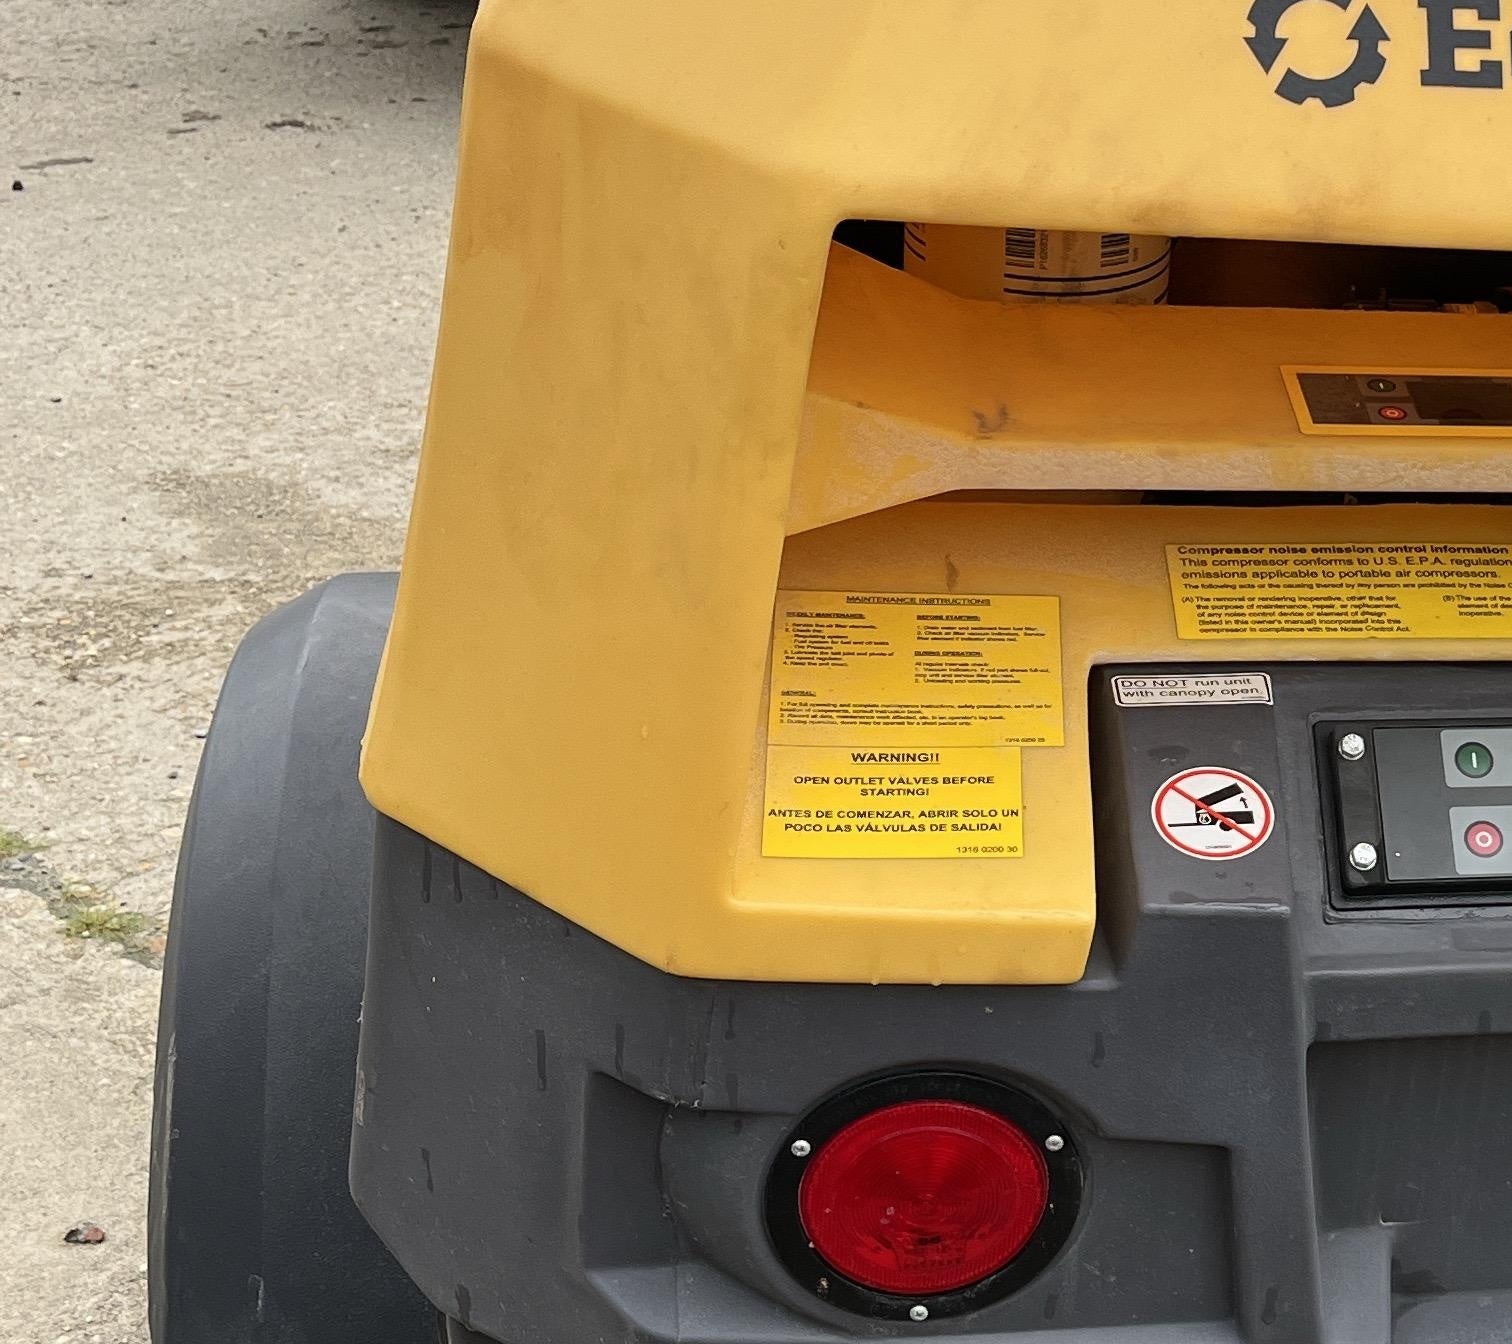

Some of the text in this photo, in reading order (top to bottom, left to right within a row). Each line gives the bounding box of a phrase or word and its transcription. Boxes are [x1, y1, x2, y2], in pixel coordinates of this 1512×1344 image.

[1178, 546, 1265, 556] Compressor
[1269, 546, 1307, 554] noise
[1311, 545, 1373, 554] emission
[1378, 545, 1426, 554] control
[1180, 558, 1208, 566] This
[1212, 558, 1289, 568] compressor
[1293, 558, 1353, 566] conforms
[1358, 558, 1369, 566] to
[1374, 557, 1399, 566] U.S.
[1406, 556, 1446, 566] E.P.A.
[1181, 569, 1500, 580] emissions applicable to portable air compressors.
[1122, 687, 1263, 697] with canopy open.
[851, 753, 940, 763] WARNING!!
[794, 776, 995, 785] OPEN OUTLET VALVES BEFORE
[860, 788, 929, 796] STARTING!
[768, 809, 1019, 819] ANTES DE COMENZAR, ABRIR SOLO UN
[784, 822, 1002, 832] POCO LAS VÁLVULAS DE SALIDA!
